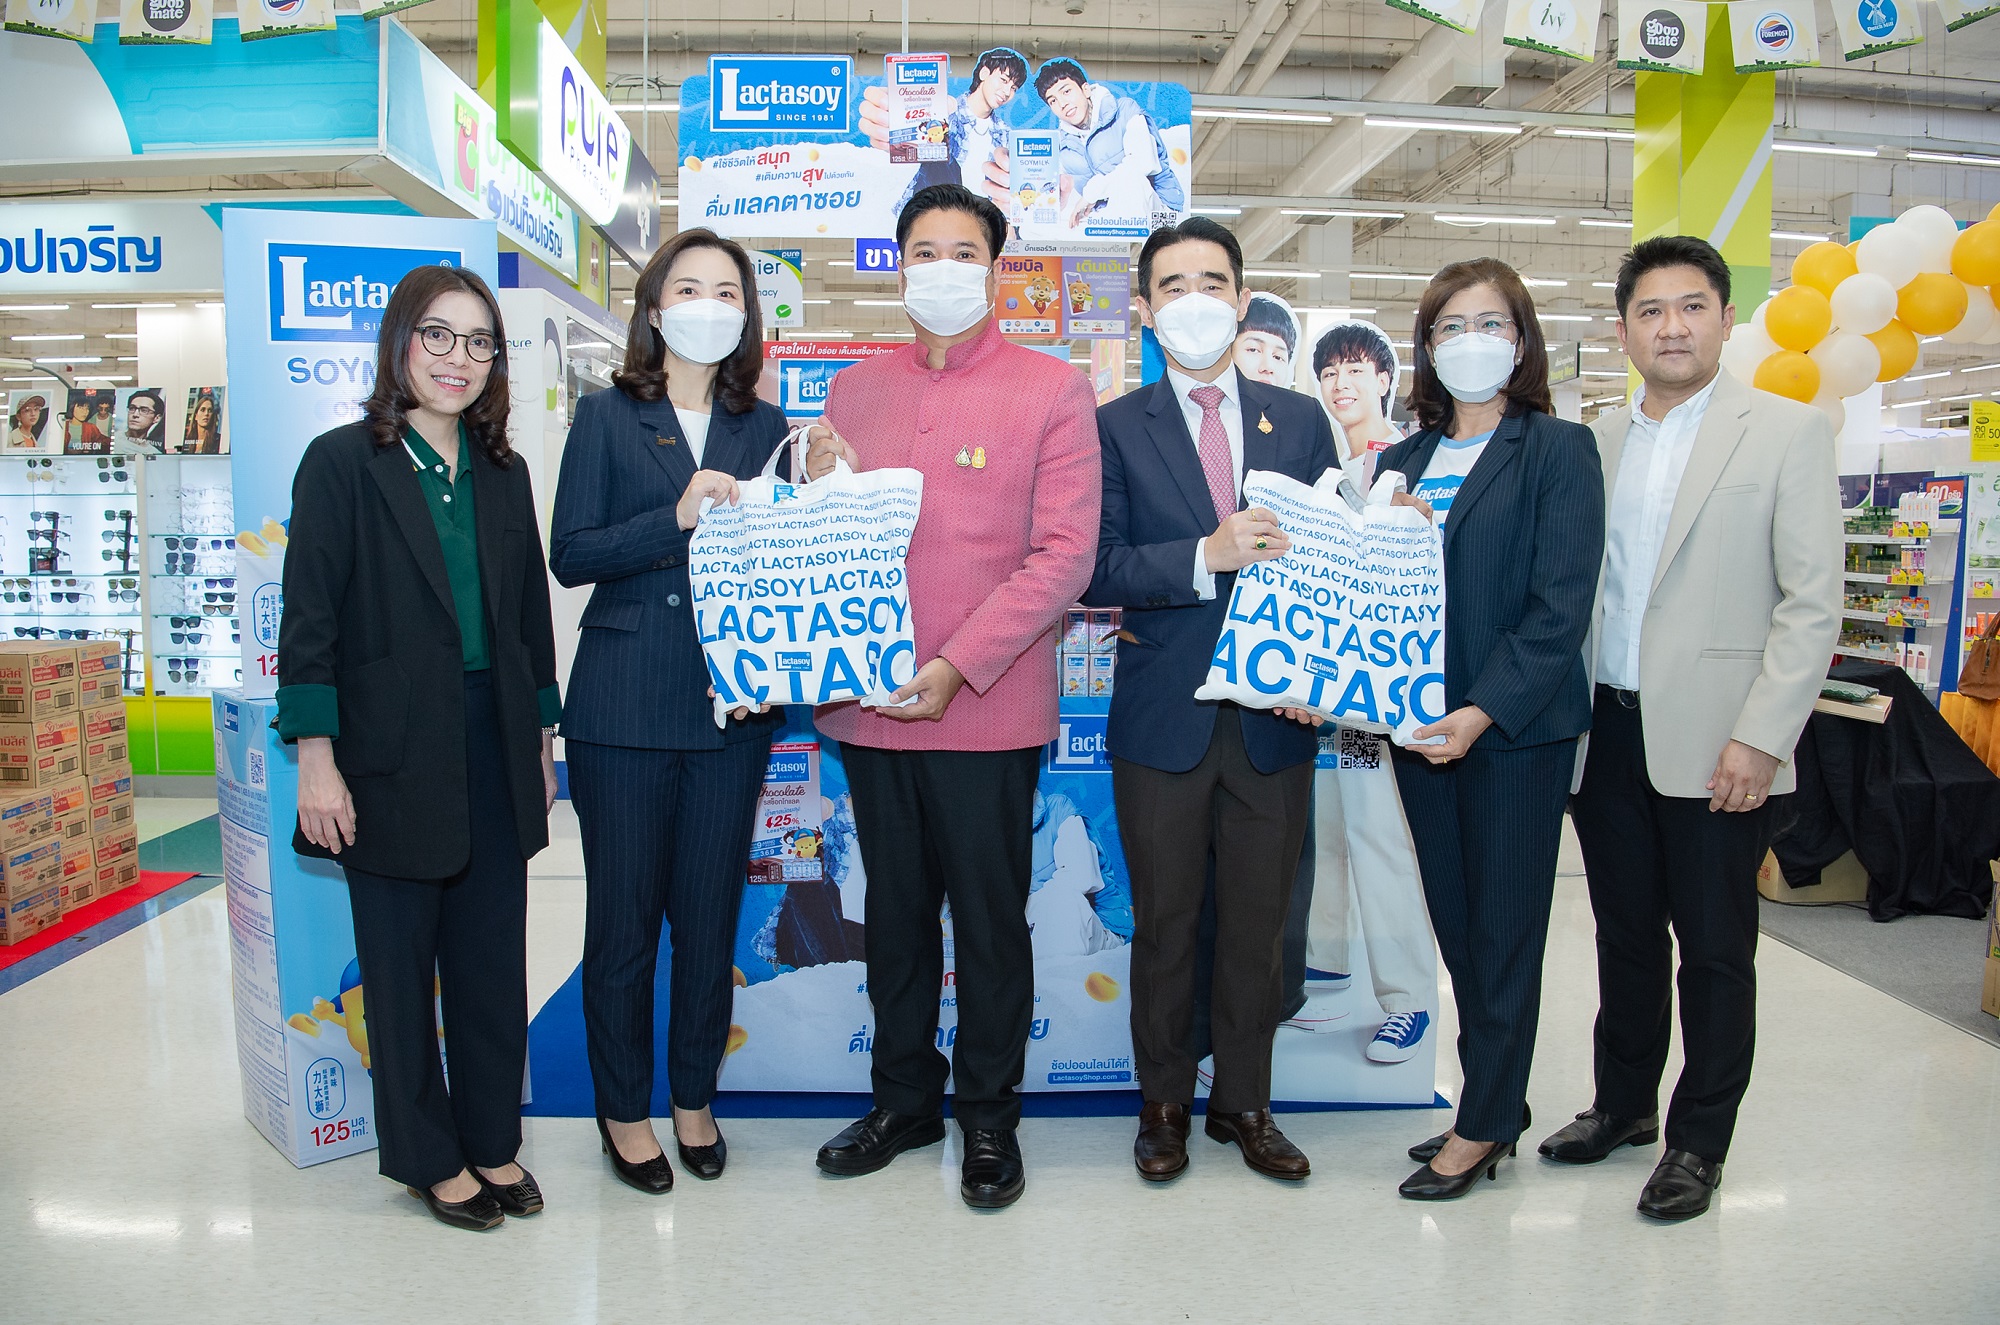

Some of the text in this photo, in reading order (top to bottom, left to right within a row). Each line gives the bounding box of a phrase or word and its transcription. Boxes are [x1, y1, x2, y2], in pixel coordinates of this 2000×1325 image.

[149, 8, 184, 20] mate
[1882, 21, 1895, 29] Mill
[1646, 34, 1679, 47] mate
[1761, 29, 1789, 38] FOREMOST
[898, 65, 937, 82] Lactasoy
[720, 68, 842, 121] Lactasoy
[899, 87, 936, 96] Chocolate
[561, 66, 618, 181] pure
[811, 114, 834, 122] 1981
[457, 104, 478, 193] Big C
[1018, 140, 1050, 155] Lactasoy
[705, 190, 861, 217] ดื่ม แลคตาซอย
[1076, 259, 1128, 273] เติมเงิน
[279, 256, 398, 330] Lacta
[769, 343, 837, 358] สูตรใหม่! อร่อย
[72, 442, 102, 450] YOU'RE ON
[883, 487, 917, 496] LACTASOY
[762, 508, 803, 519] LACTASOY
[805, 502, 844, 514] LACTASOY
[1280, 495, 1313, 512] LACTASOY
[778, 516, 828, 529] LACTASOY
[830, 515, 879, 525] LACTASOY
[1281, 508, 1320, 524] LACTASOY
[1284, 523, 1334, 543] LACTASOY
[691, 543, 747, 557] LACTASOY
[805, 531, 867, 547] LACTASOY
[761, 549, 849, 571] LACTASOY
[1293, 544, 1355, 568] LACTASOY
[1365, 547, 1409, 559] LACTASOY
[697, 595, 908, 645] LACTASOY
[1229, 585, 1441, 668] LACTASOY
[776, 653, 811, 669] Lactasoy
[1305, 655, 1338, 677] Lactasoy
[749, 875, 762, 883] 125
[1051, 1055, 1130, 1070] ช้อปออนไลน์ได้ที่
[1053, 1073, 1117, 1082] LactasoyShop.com
[312, 1071, 324, 1114] 力大獅
[310, 1119, 350, 1147] 125
[352, 1126, 369, 1138] ml.
